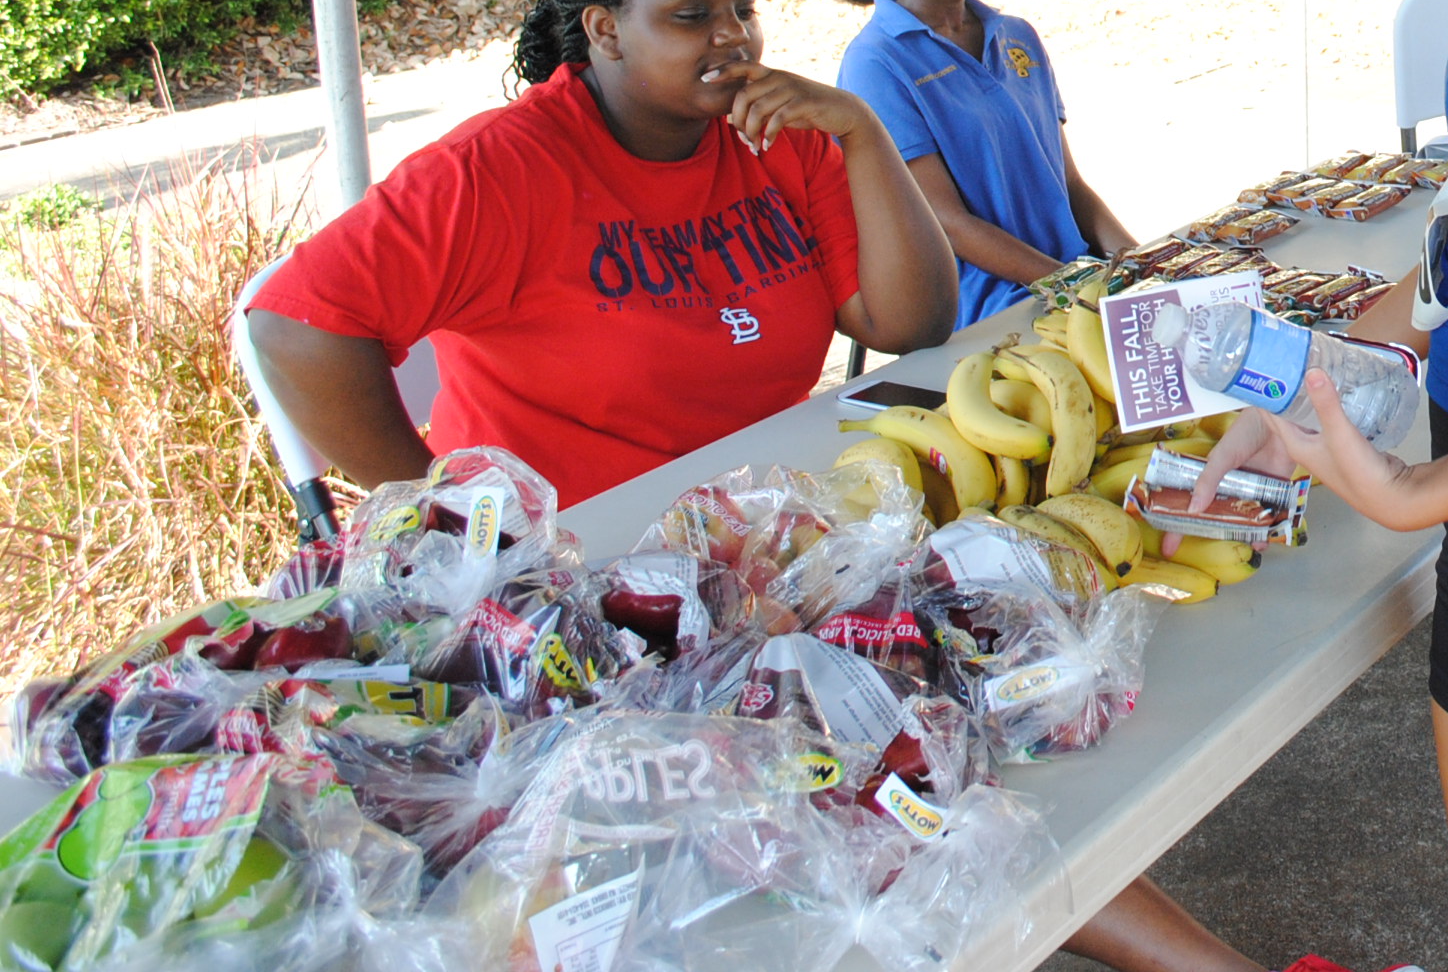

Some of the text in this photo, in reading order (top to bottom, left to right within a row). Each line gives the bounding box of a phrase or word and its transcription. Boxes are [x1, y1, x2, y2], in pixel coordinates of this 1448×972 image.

[589, 240, 711, 299] OUR
[596, 299, 637, 313] ST.
[651, 296, 714, 310] LOUIS
[1139, 300, 1154, 334] FOR
[1121, 303, 1154, 419] THIS FALL,
[1150, 374, 1169, 415] TAKE
[1163, 364, 1184, 412] YOUR
[896, 625, 922, 639] RED
